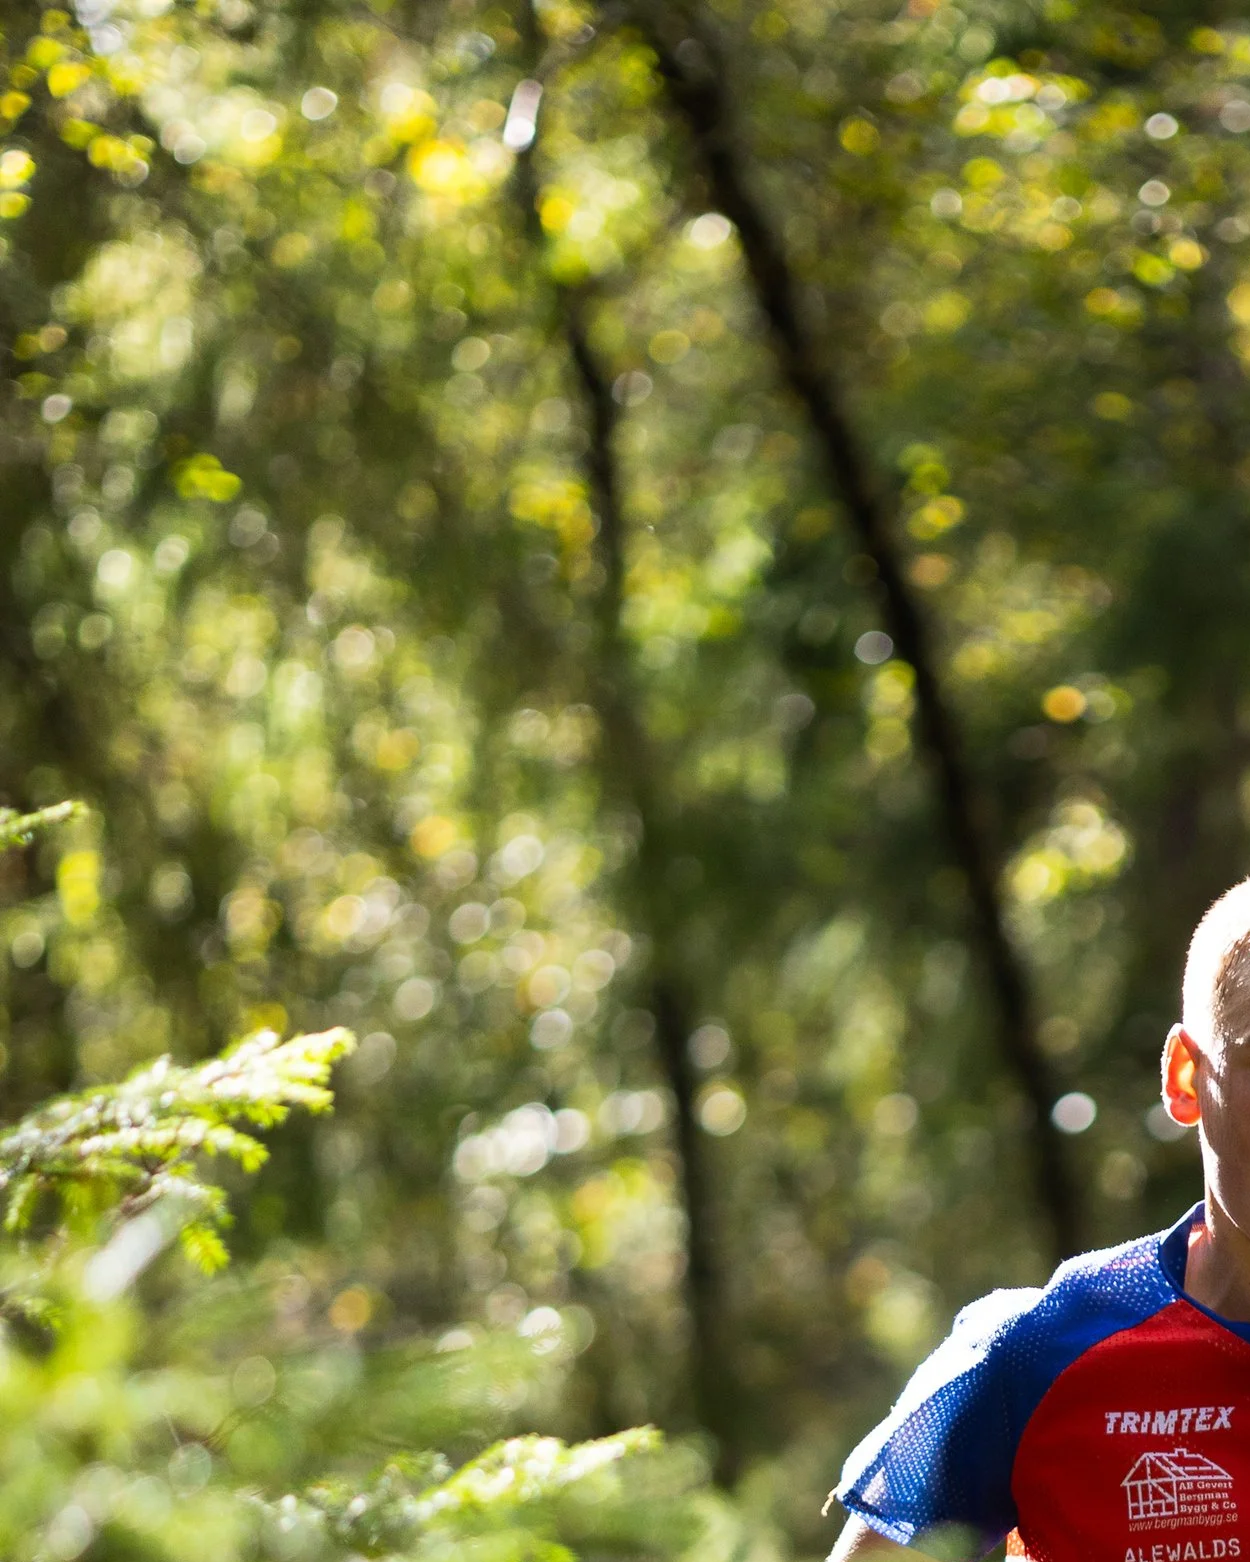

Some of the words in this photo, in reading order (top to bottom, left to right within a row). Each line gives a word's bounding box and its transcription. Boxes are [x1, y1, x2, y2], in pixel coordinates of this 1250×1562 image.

[1105, 1406, 1236, 1435] TRIMTEX
[1179, 1481, 1194, 1490] AB
[1179, 1492, 1229, 1501] Bergman
[1180, 1504, 1208, 1514] Bygg
[1211, 1501, 1219, 1510] &
[1222, 1501, 1237, 1509] Co
